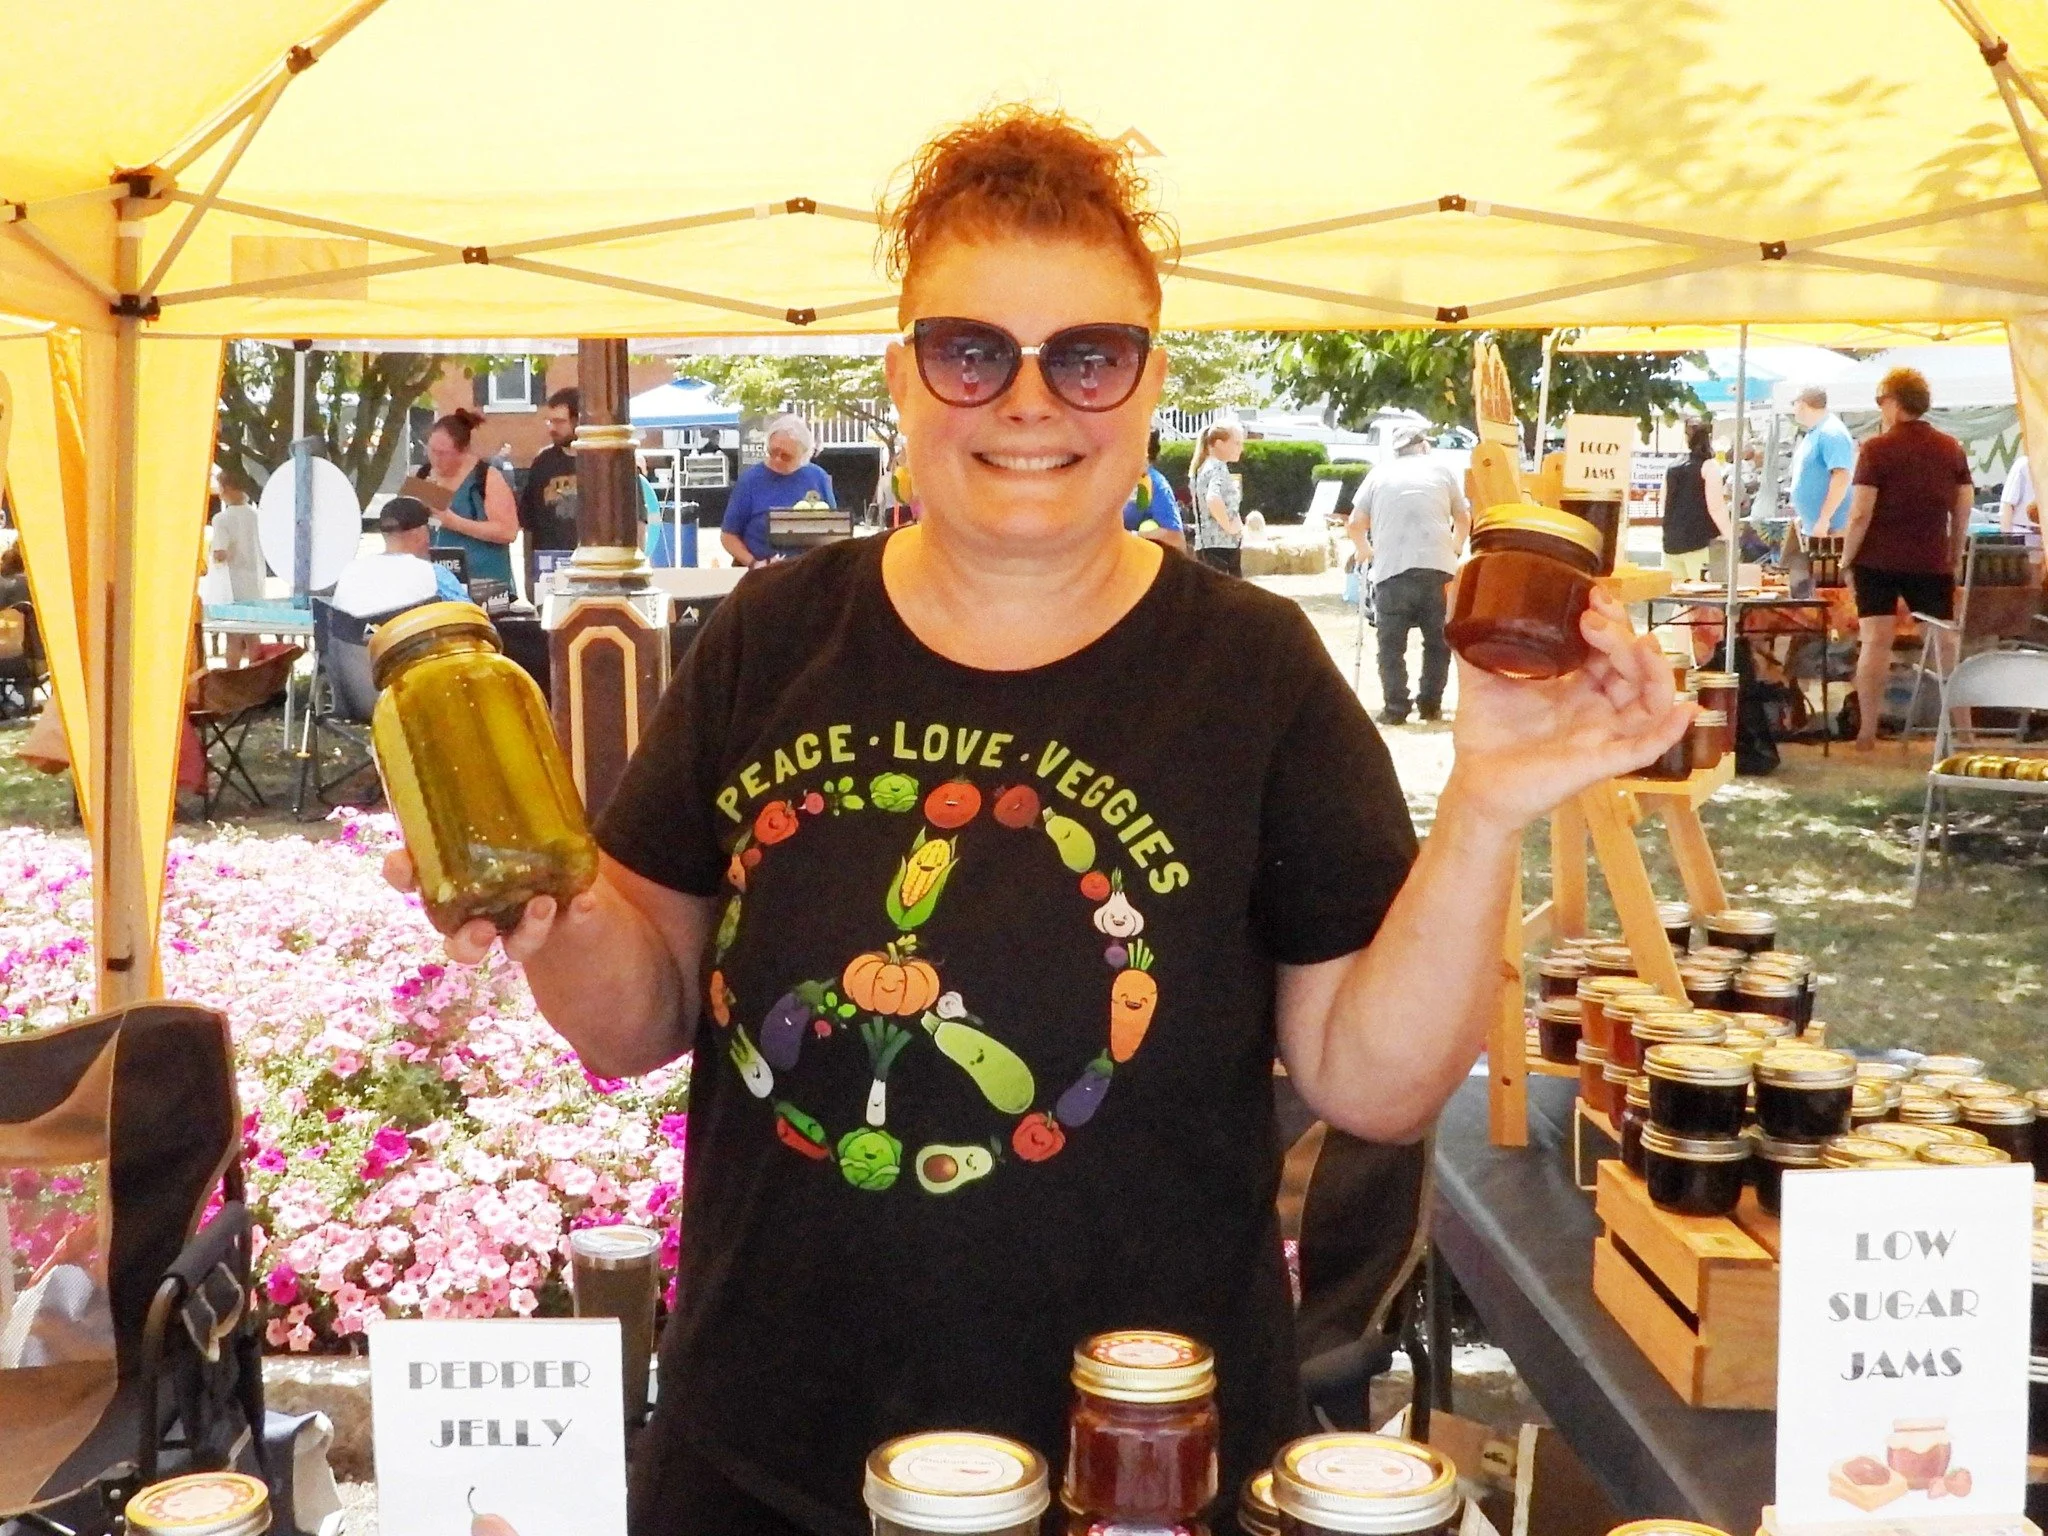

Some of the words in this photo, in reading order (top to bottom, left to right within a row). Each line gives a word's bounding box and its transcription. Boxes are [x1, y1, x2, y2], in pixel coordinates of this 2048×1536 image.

[1583, 466, 1616, 480] JAMS
[716, 724, 855, 823] PEACE
[893, 720, 1014, 768] LOVE
[1036, 740, 1189, 894] VEGGIES
[1855, 1228, 1957, 1261] LOW
[1828, 1287, 1980, 1322] SUGAR
[408, 1360, 591, 1390] PEPPER
[1840, 1347, 1963, 1381] JAMS
[430, 1418, 573, 1449] JELLY
